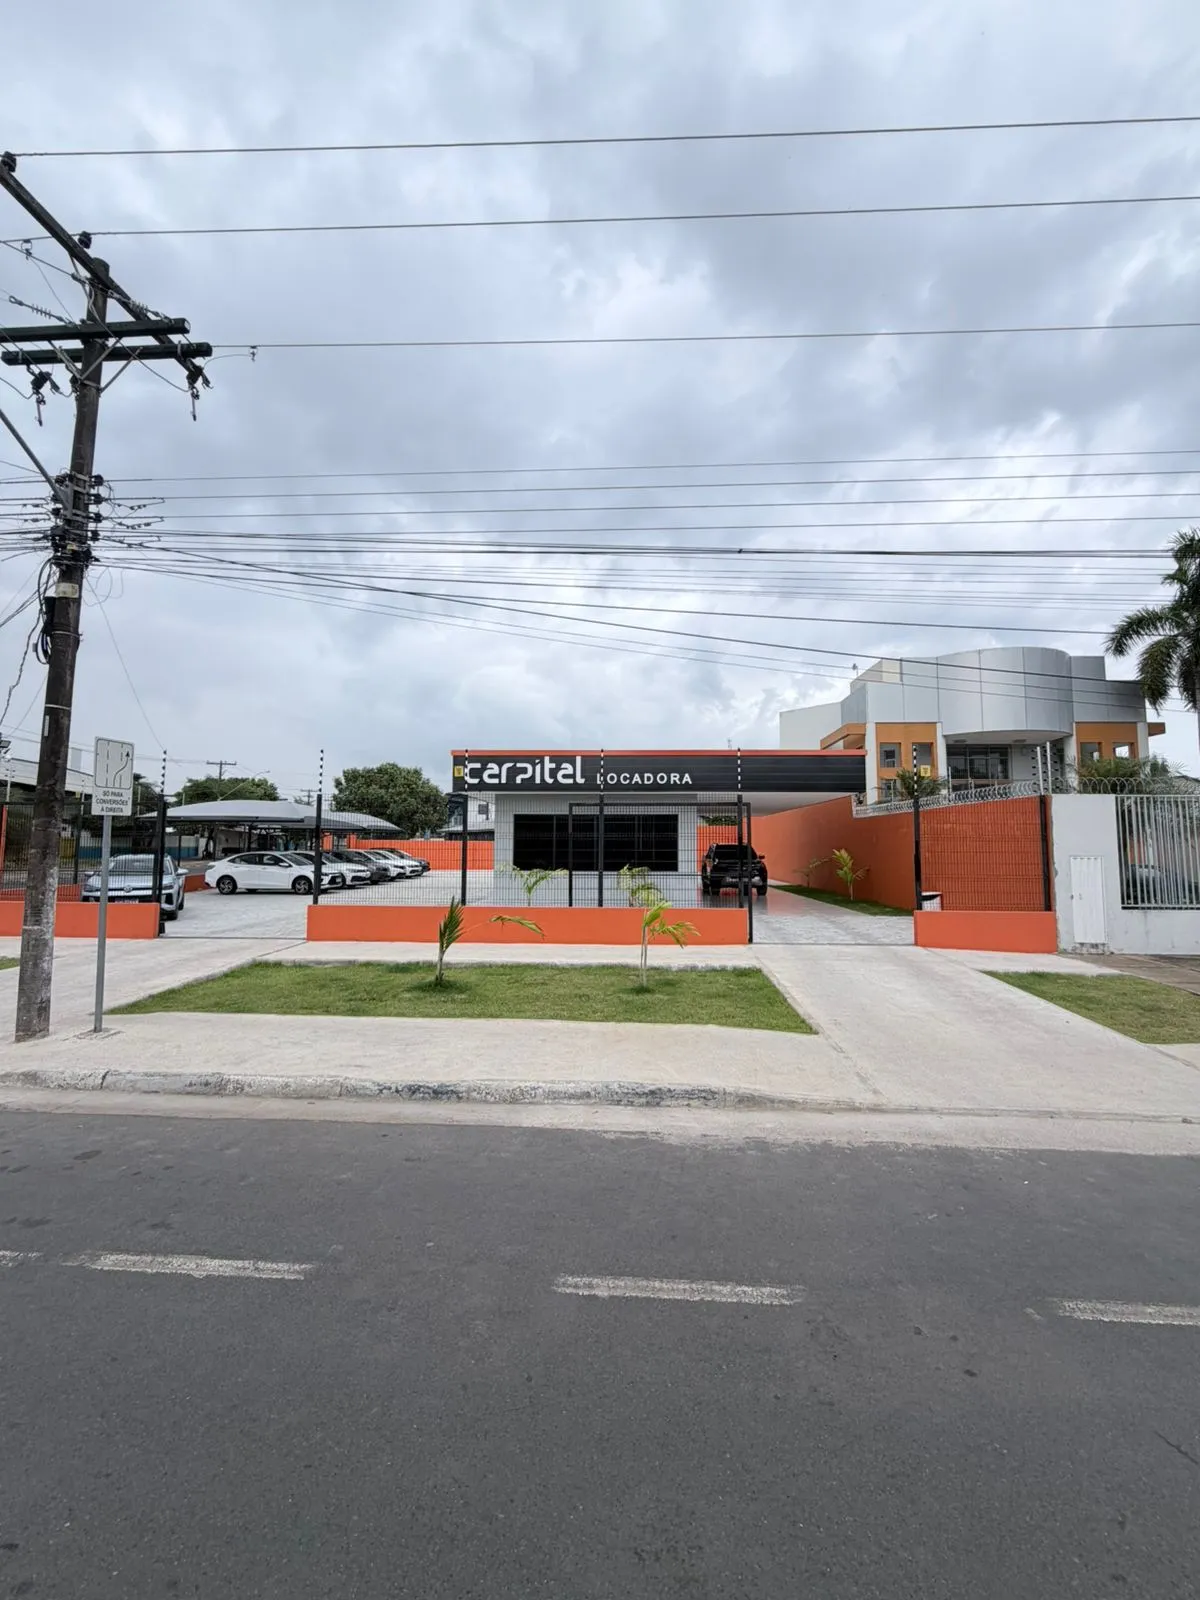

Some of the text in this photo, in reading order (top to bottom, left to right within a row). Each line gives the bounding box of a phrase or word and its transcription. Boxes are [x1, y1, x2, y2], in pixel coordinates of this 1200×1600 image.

[465, 756, 585, 784] carpital
[597, 772, 693, 785] LOCADORA
[96, 798, 128, 806] CONVERSÕES
